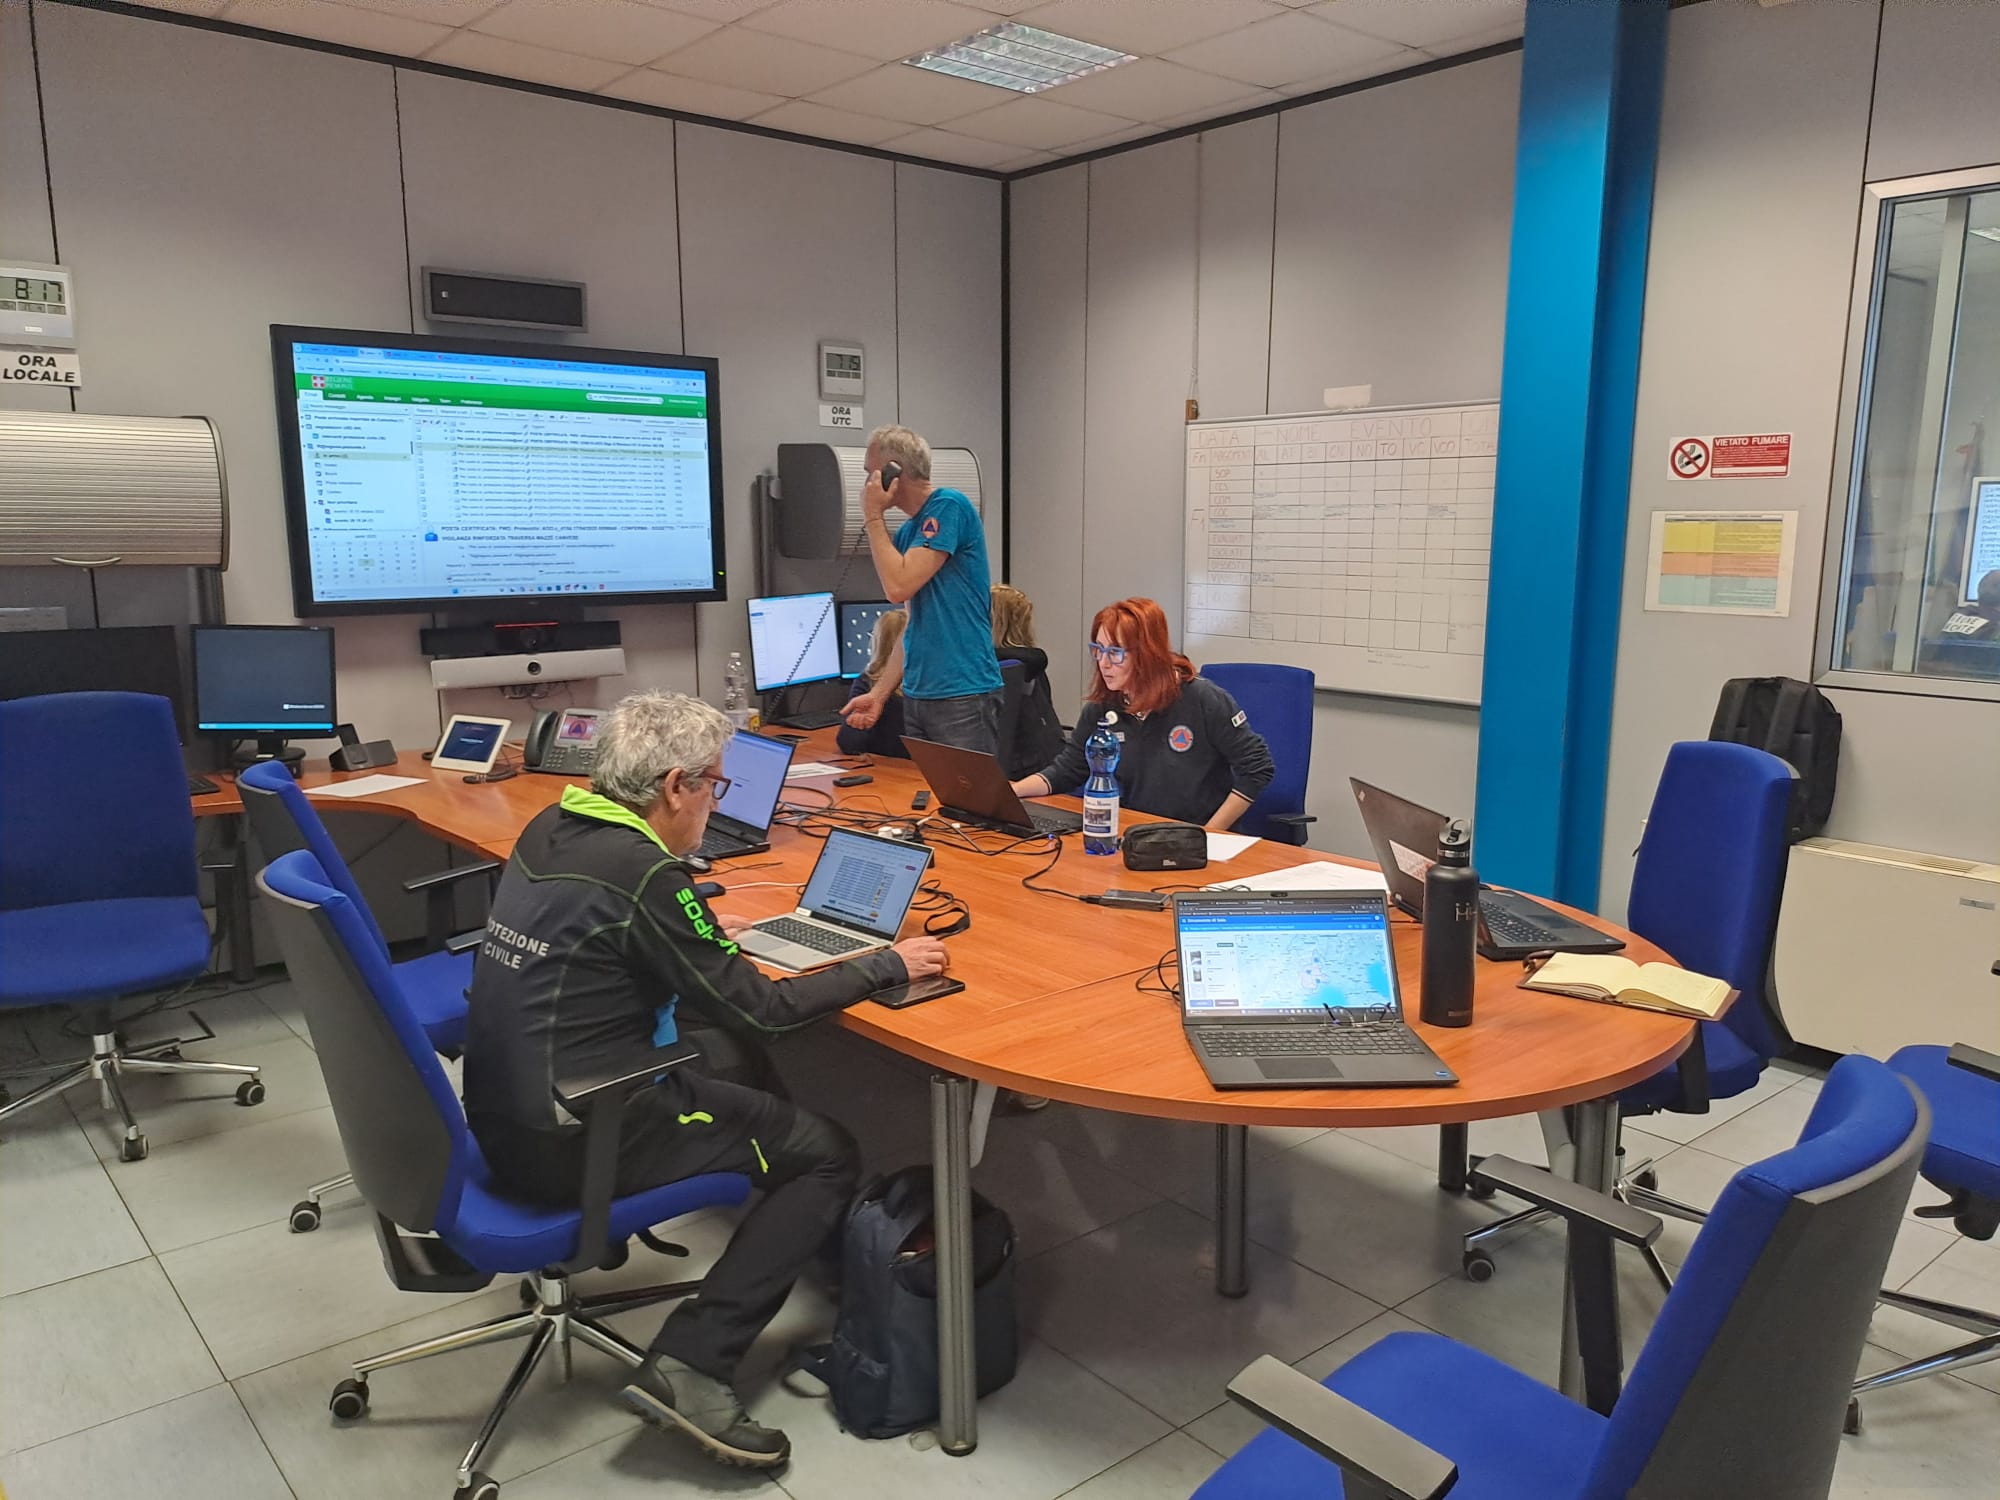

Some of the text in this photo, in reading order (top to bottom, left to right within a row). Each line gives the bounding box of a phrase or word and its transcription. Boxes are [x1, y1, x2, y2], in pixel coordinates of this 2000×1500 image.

[18, 354, 57, 368] ORA
[3, 368, 75, 383] LOCALE
[831, 406, 851, 415] ORA
[832, 417, 852, 426] UTC
[1350, 417, 1432, 439] EVENTO
[1714, 435, 1789, 447] VIETATO FUMARE
[1379, 442, 1398, 456] TO
[487, 916, 550, 957] OTEZIONE
[484, 941, 523, 970] CIVILE
